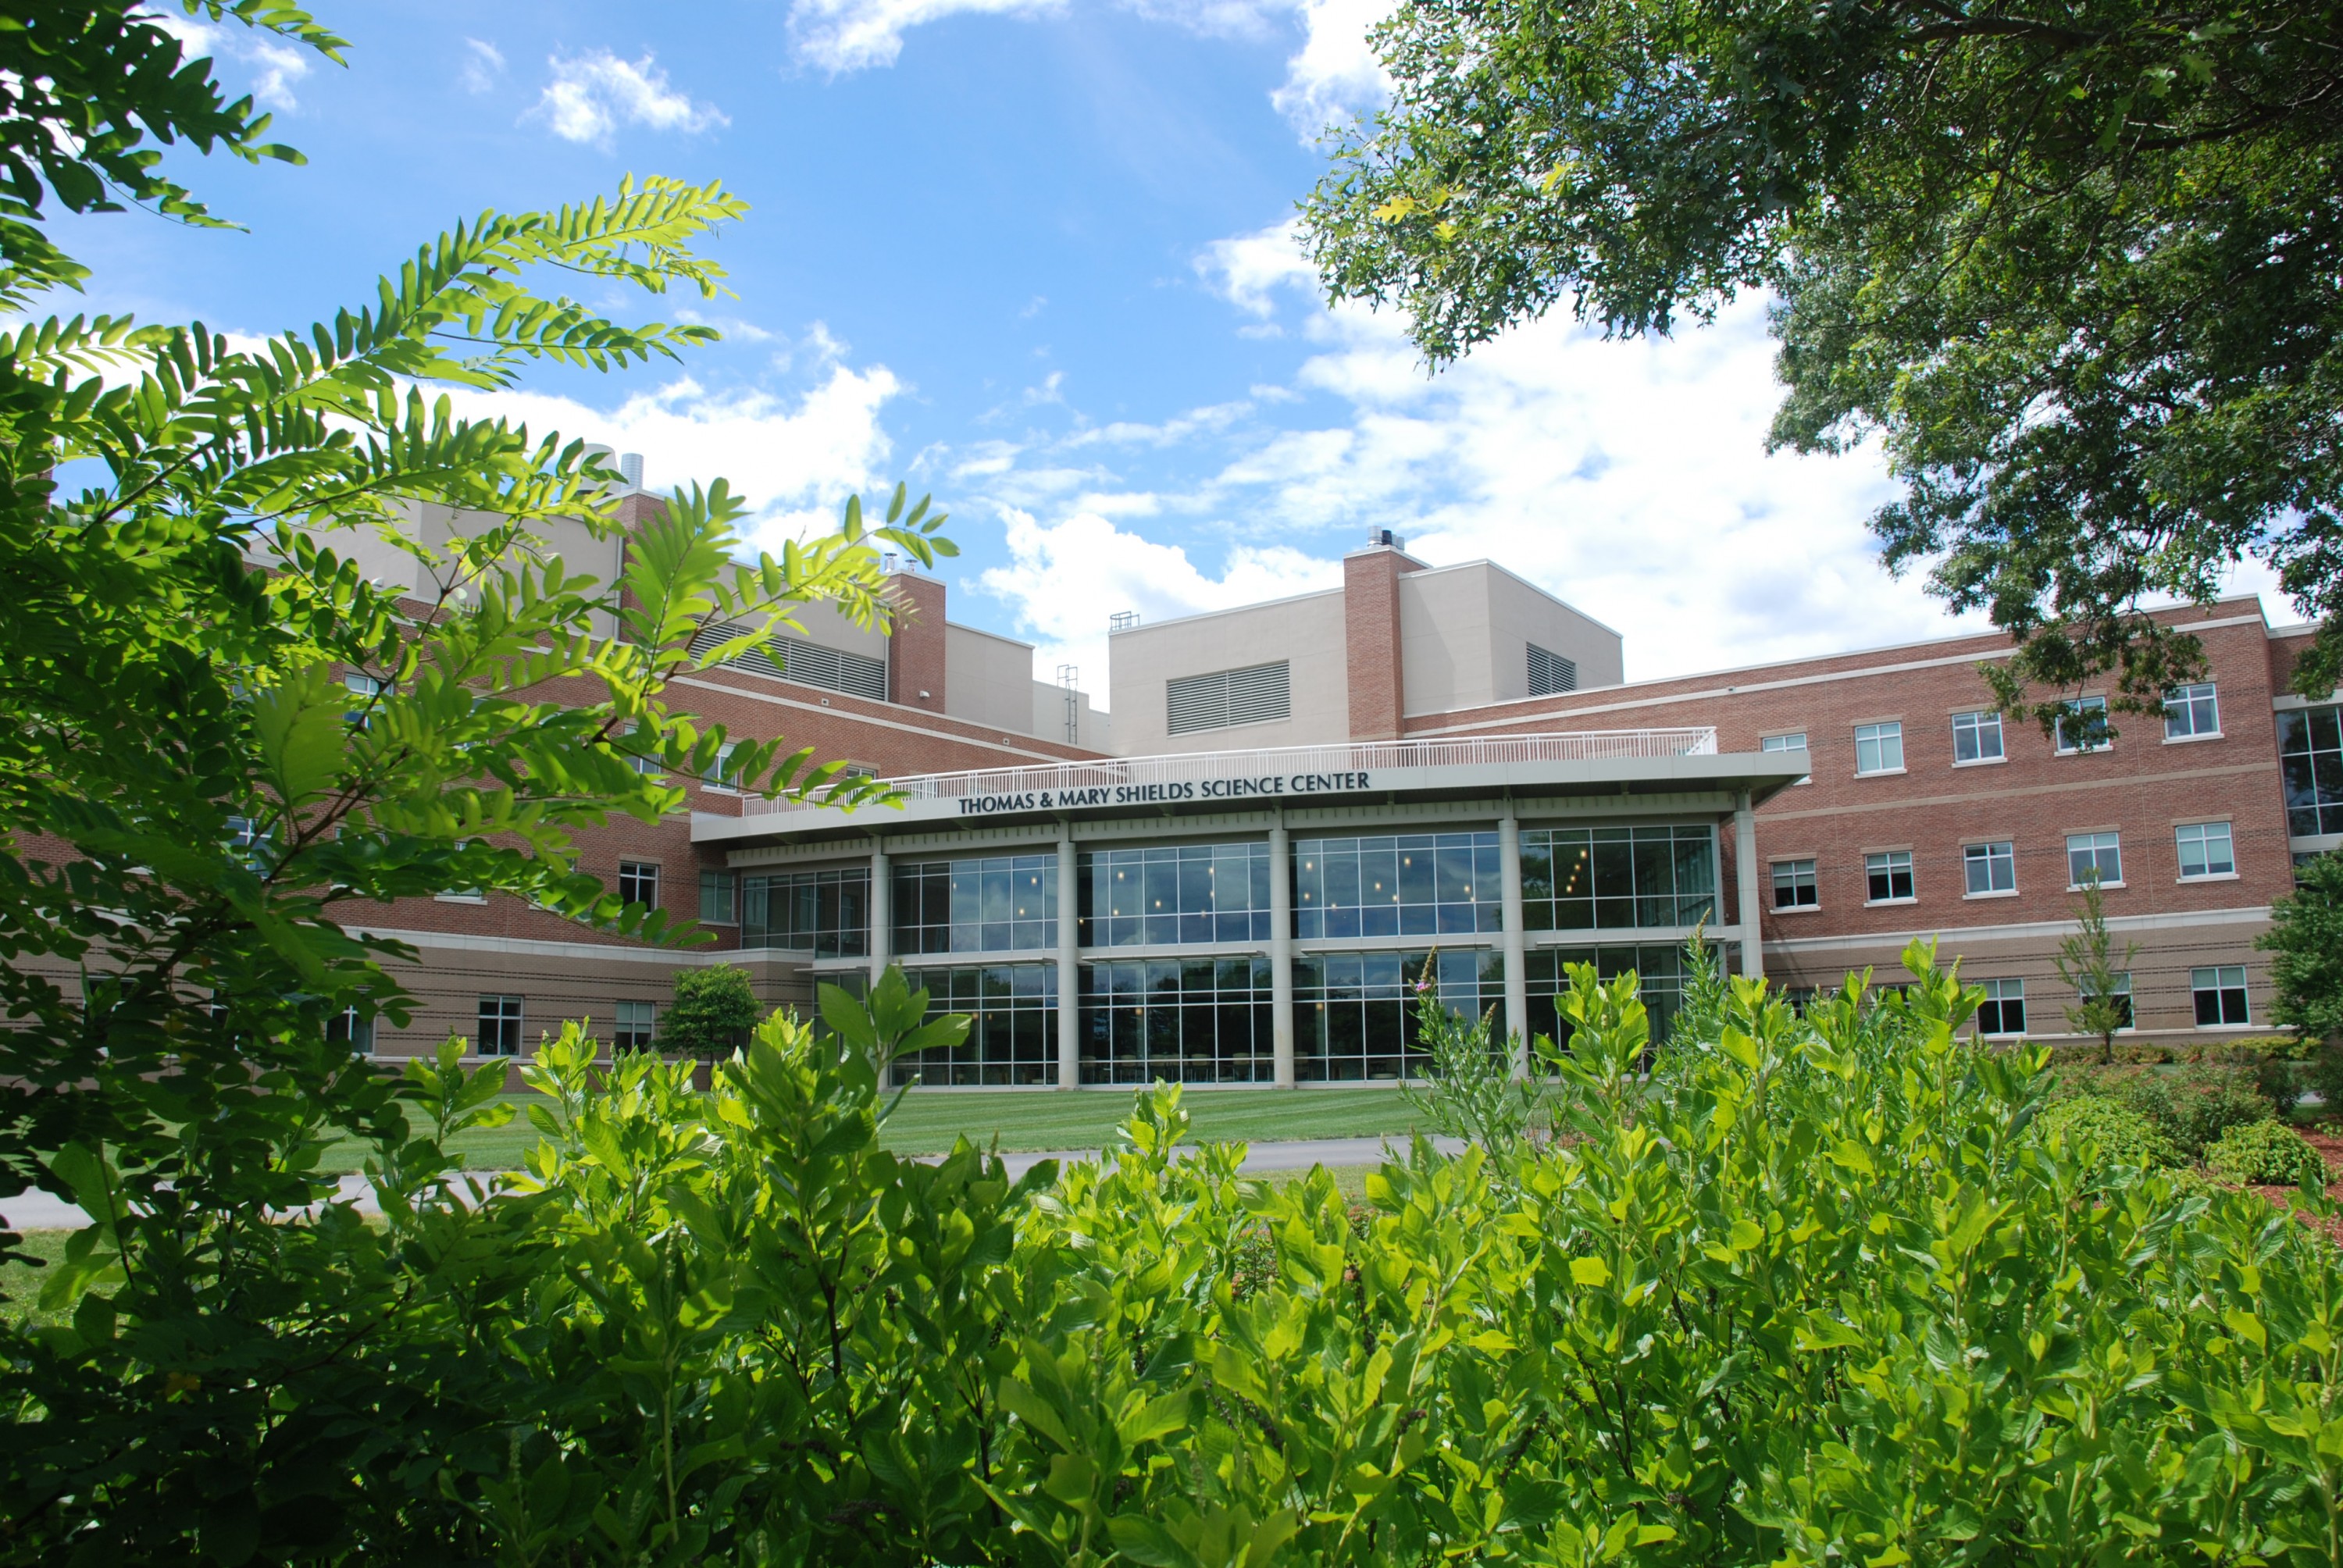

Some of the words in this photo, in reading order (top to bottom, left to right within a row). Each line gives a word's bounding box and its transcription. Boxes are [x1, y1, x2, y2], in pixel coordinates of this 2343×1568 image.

[958, 793, 1035, 814] THOMAS
[1040, 792, 1053, 807] &
[1058, 788, 1111, 806] MARY
[1116, 782, 1193, 803] SHIELDS
[1201, 776, 1283, 797] SCIENCE
[1291, 772, 1370, 792] CENTER
